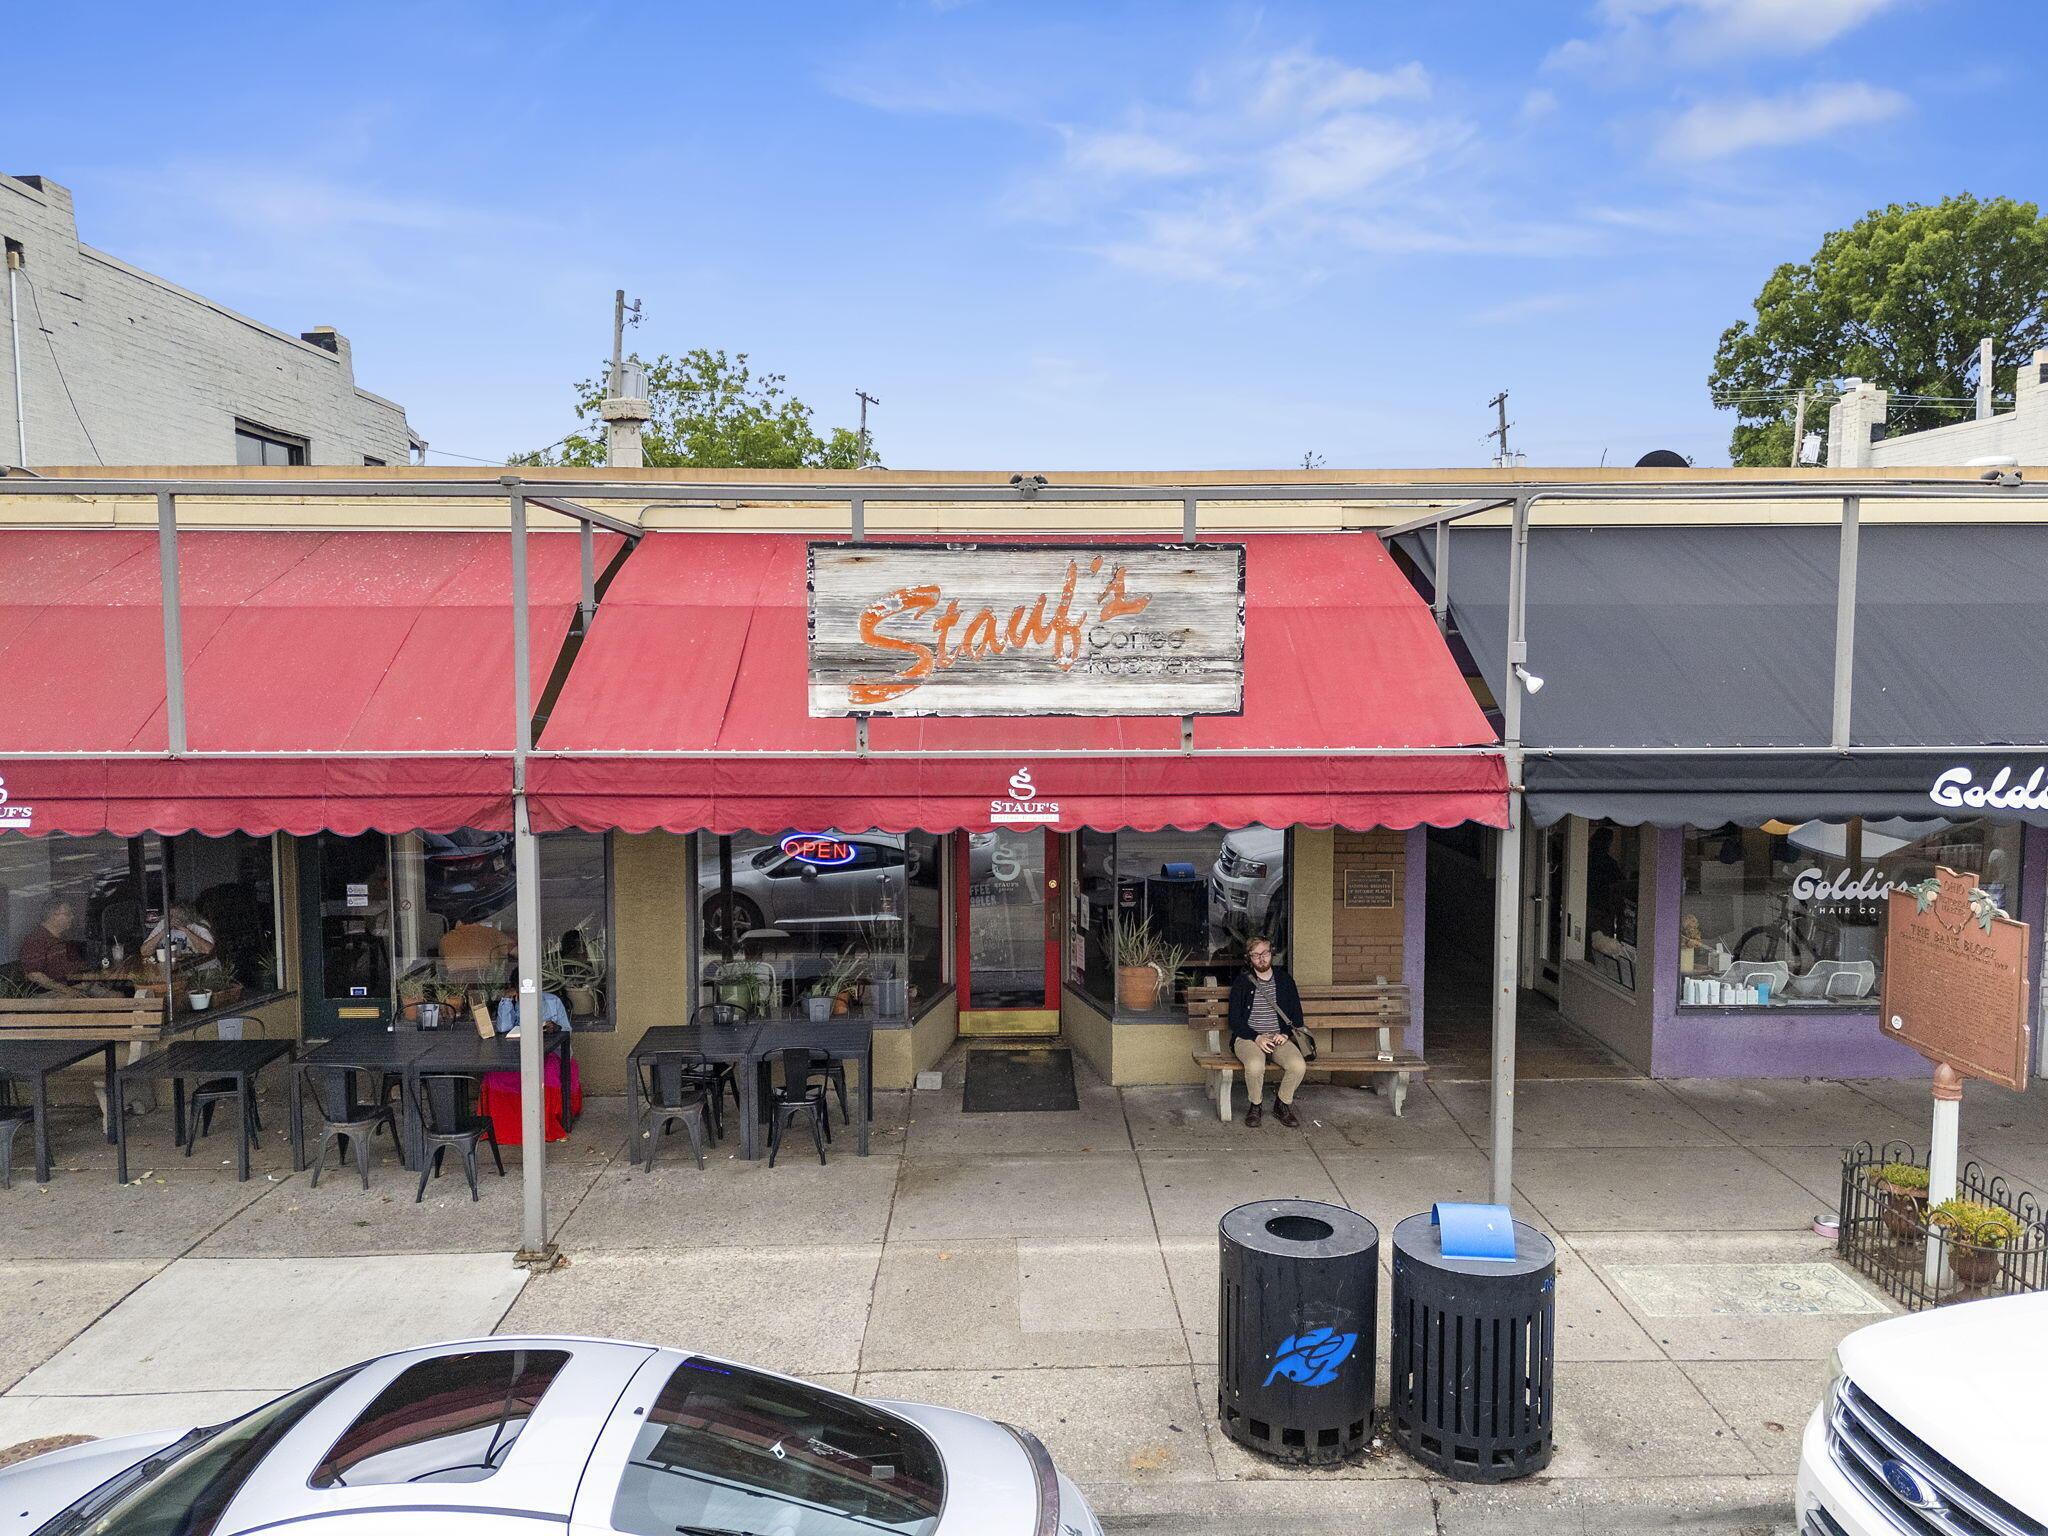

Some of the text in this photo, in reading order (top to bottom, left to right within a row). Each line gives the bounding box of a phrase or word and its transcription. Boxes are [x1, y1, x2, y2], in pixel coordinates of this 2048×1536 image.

[848, 556, 1152, 704] Stauf's
[991, 801, 1059, 813] STAUF'S
[785, 841, 847, 859] OPEN
